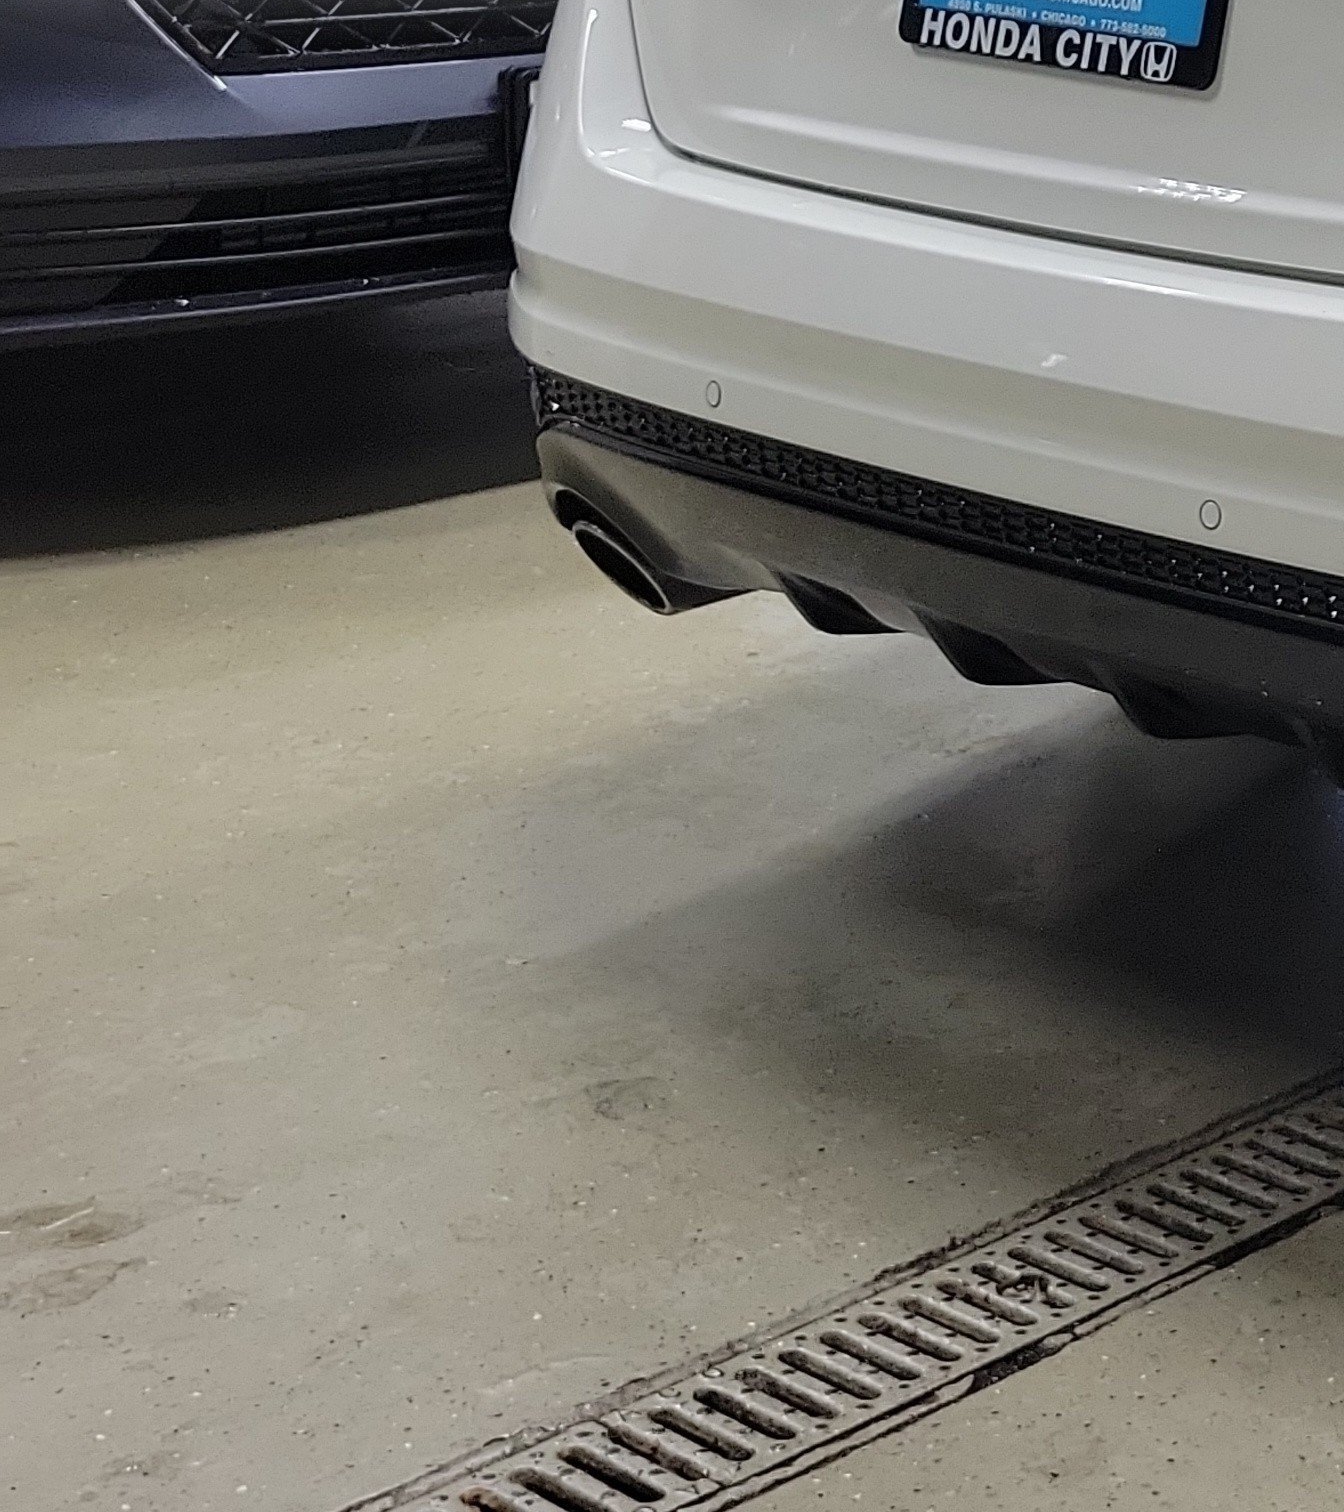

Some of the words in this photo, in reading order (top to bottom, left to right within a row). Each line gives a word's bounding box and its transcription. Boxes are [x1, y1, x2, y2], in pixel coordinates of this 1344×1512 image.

[1041, 10, 1087, 28] CHICAGO
[919, 7, 1042, 63] HONDA
[1055, 28, 1142, 77] CITY
